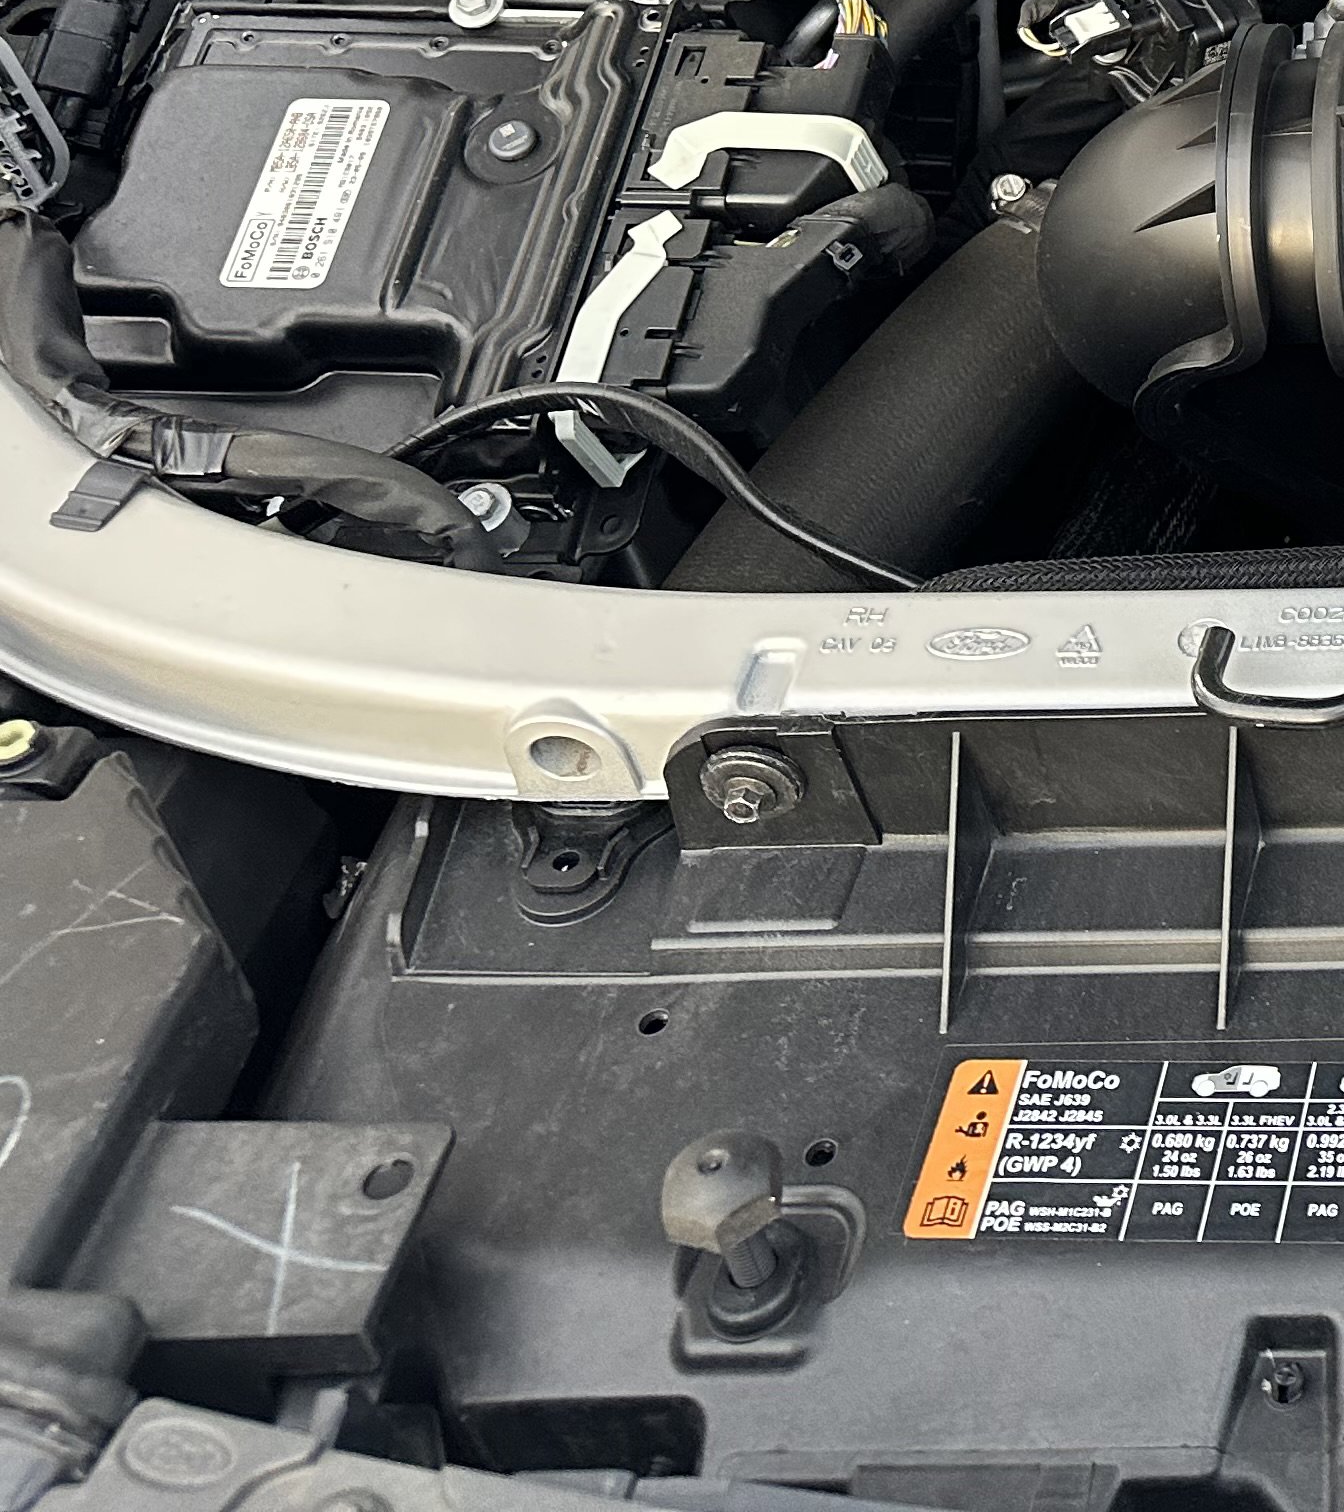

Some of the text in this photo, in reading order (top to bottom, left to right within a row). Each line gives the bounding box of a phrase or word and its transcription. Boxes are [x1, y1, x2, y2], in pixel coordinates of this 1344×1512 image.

[337, 144, 349, 163] Made
[302, 217, 328, 259] BOSCH
[234, 222, 268, 278] FoMoCo
[843, 607, 889, 626] RH
[1022, 1070, 1120, 1090] FoMoCo
[1018, 1094, 1091, 1106] SAE J639
[1013, 1110, 1104, 1122] J2842 J2845
[1155, 1115, 1222, 1126] 3.0L & 3.3L
[1230, 1115, 1295, 1126] 3.3L FHEV
[1306, 1116, 1333, 1126] 3.0L
[1334, 1116, 1344, 1126] &
[1005, 1133, 1097, 1153] R-1234yf
[1151, 1133, 1216, 1152] 0.680 kg
[1226, 1134, 1290, 1152] 0.737 kg
[1162, 1150, 1198, 1163] 24 oz
[1236, 1150, 1273, 1164] 26 oz
[1317, 1150, 1335, 1163] 35
[998, 1155, 1082, 1176] (GWP 4)
[1152, 1165, 1200, 1178] 1.50 lbs
[1227, 1165, 1276, 1178] 1.63 lbs
[1306, 1165, 1335, 1178] 2.19
[985, 1200, 1026, 1216] PAG
[1152, 1201, 1184, 1215] PAG
[1230, 1202, 1261, 1216] POE
[1307, 1203, 1339, 1217] PAG
[980, 1216, 1023, 1232] POE
